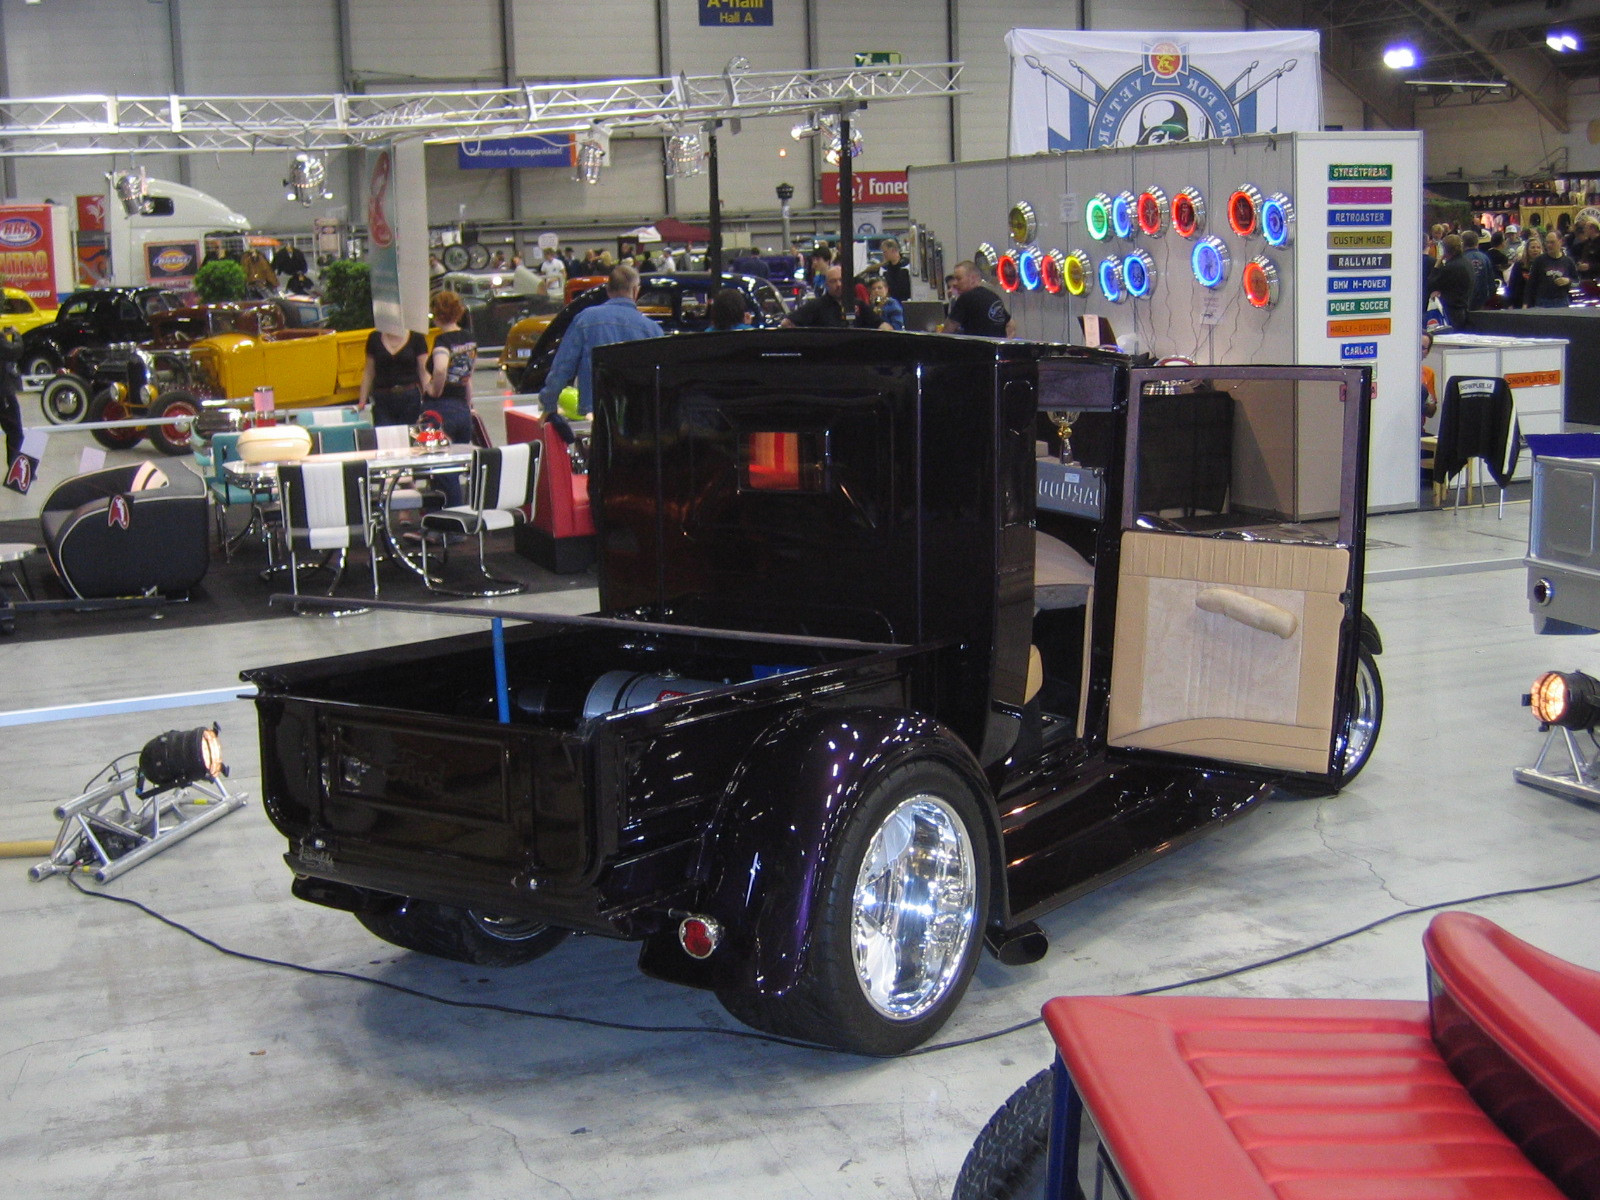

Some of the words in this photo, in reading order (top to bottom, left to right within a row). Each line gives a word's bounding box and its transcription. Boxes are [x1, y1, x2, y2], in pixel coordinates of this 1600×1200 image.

[720, 12, 740, 23] Hall
[744, 12, 755, 23] A
[1333, 167, 1388, 178] STREETFREAK
[1335, 212, 1385, 222] RETROASTER
[1366, 235, 1386, 245] MADE
[1338, 256, 1383, 267] RALLYART
[1333, 280, 1349, 290] BMW
[1352, 279, 1387, 289] M-POWER
[1330, 301, 1356, 312] POWER
[1360, 300, 1389, 311] SOCCER
[1344, 345, 1374, 356] CARLOS
